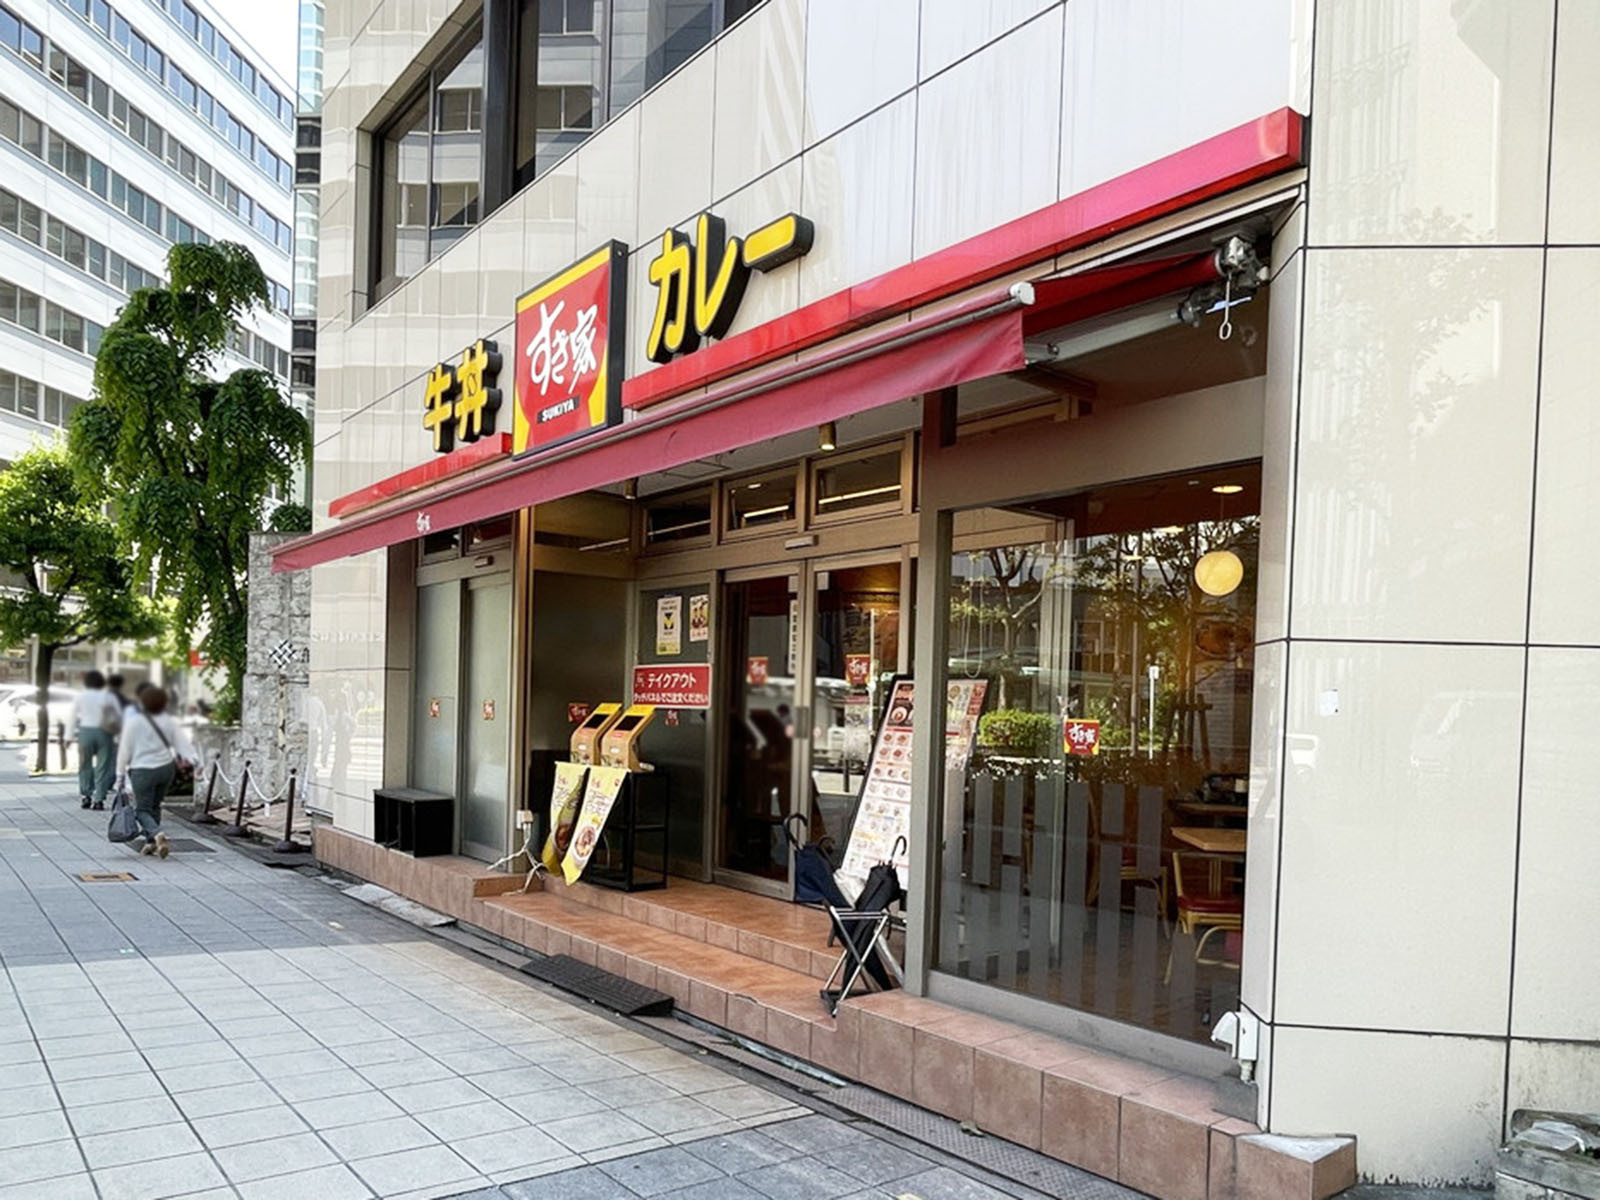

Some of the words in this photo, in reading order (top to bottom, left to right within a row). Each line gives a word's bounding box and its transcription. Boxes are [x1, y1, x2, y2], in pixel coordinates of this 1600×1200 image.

[646, 212, 799, 361] カレー
[423, 339, 493, 452] 牛丼
[525, 300, 599, 396] すき家
[541, 398, 575, 422] SUKIYA
